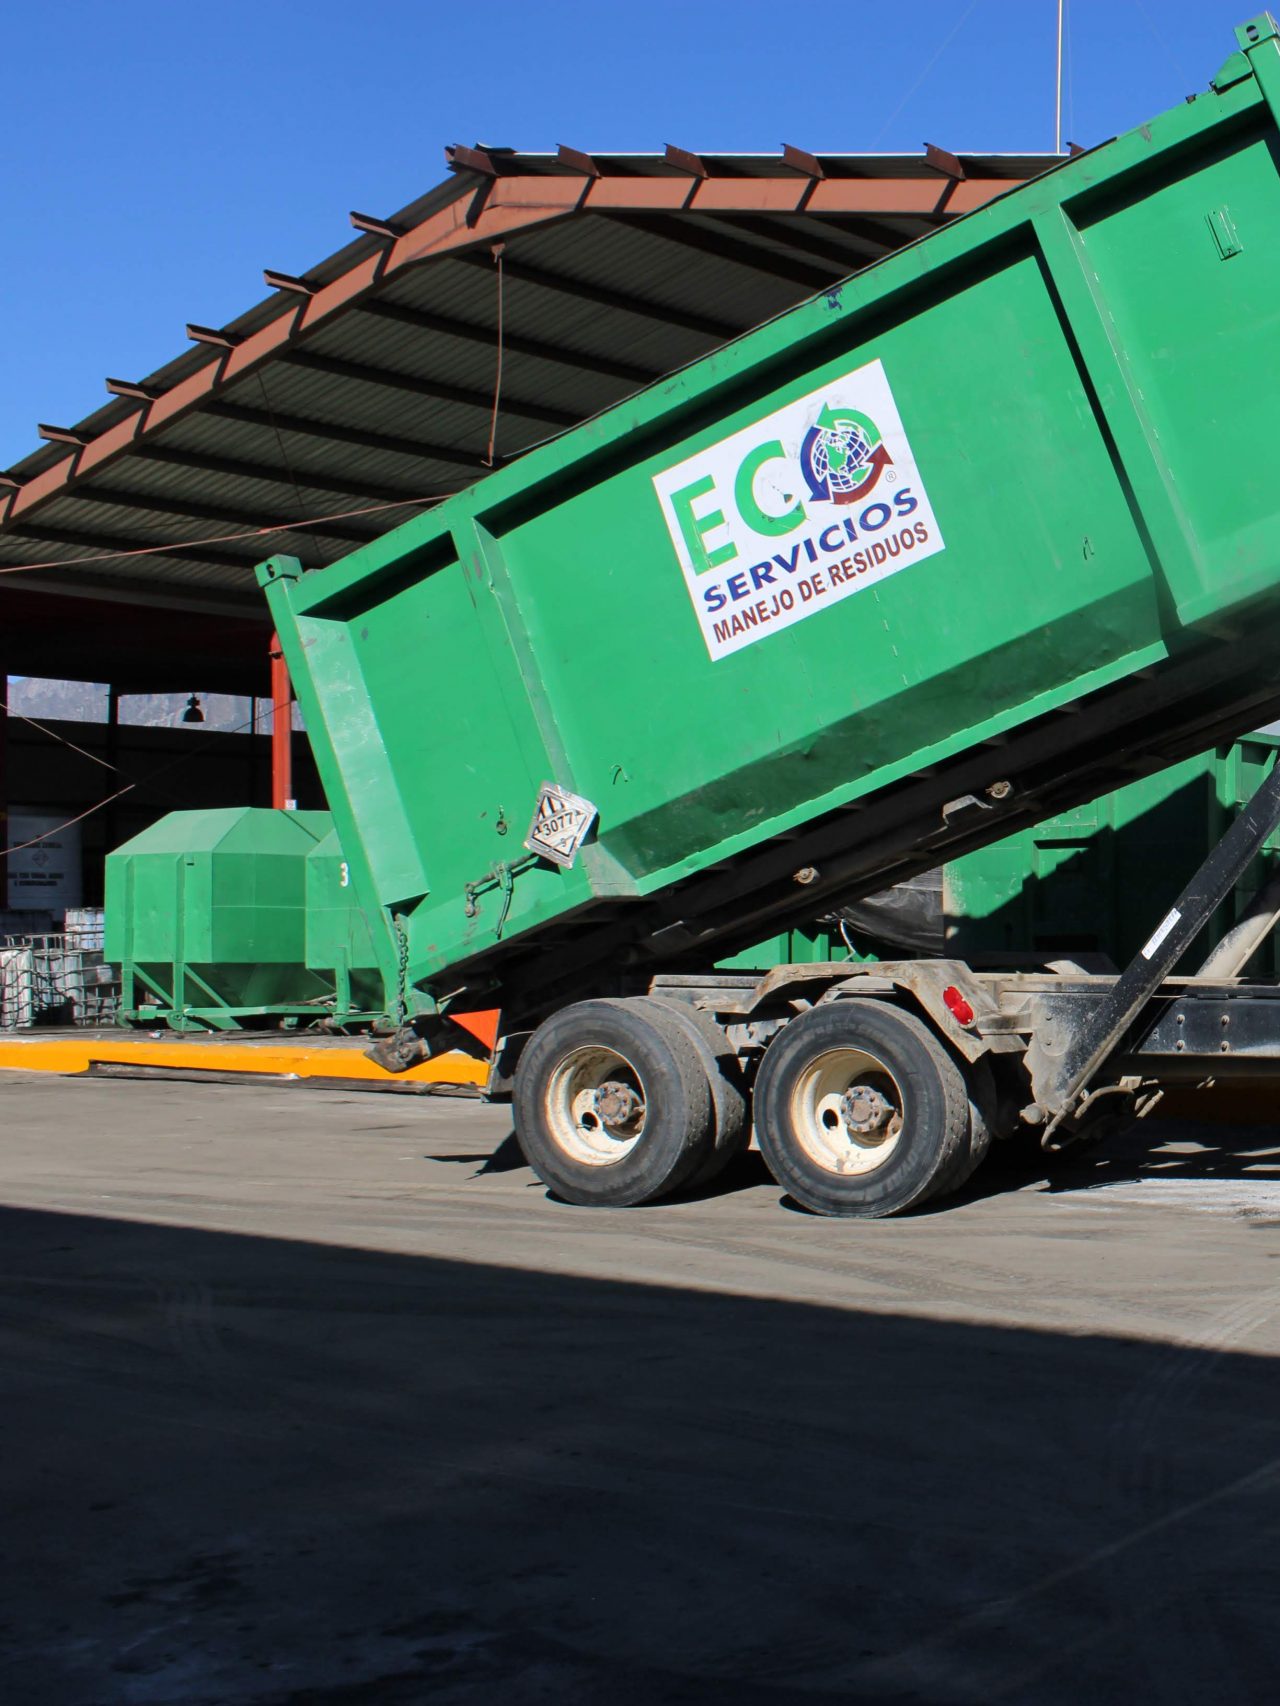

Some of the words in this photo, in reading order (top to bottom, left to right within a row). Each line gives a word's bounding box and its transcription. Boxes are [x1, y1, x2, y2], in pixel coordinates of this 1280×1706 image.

[670, 402, 894, 577] ECO
[703, 487, 918, 613] SERVICIOS
[713, 589, 794, 644] MANEJO
[798, 573, 826, 602] DE
[828, 521, 929, 587] RESIDUOS
[543, 811, 574, 836] 3077
